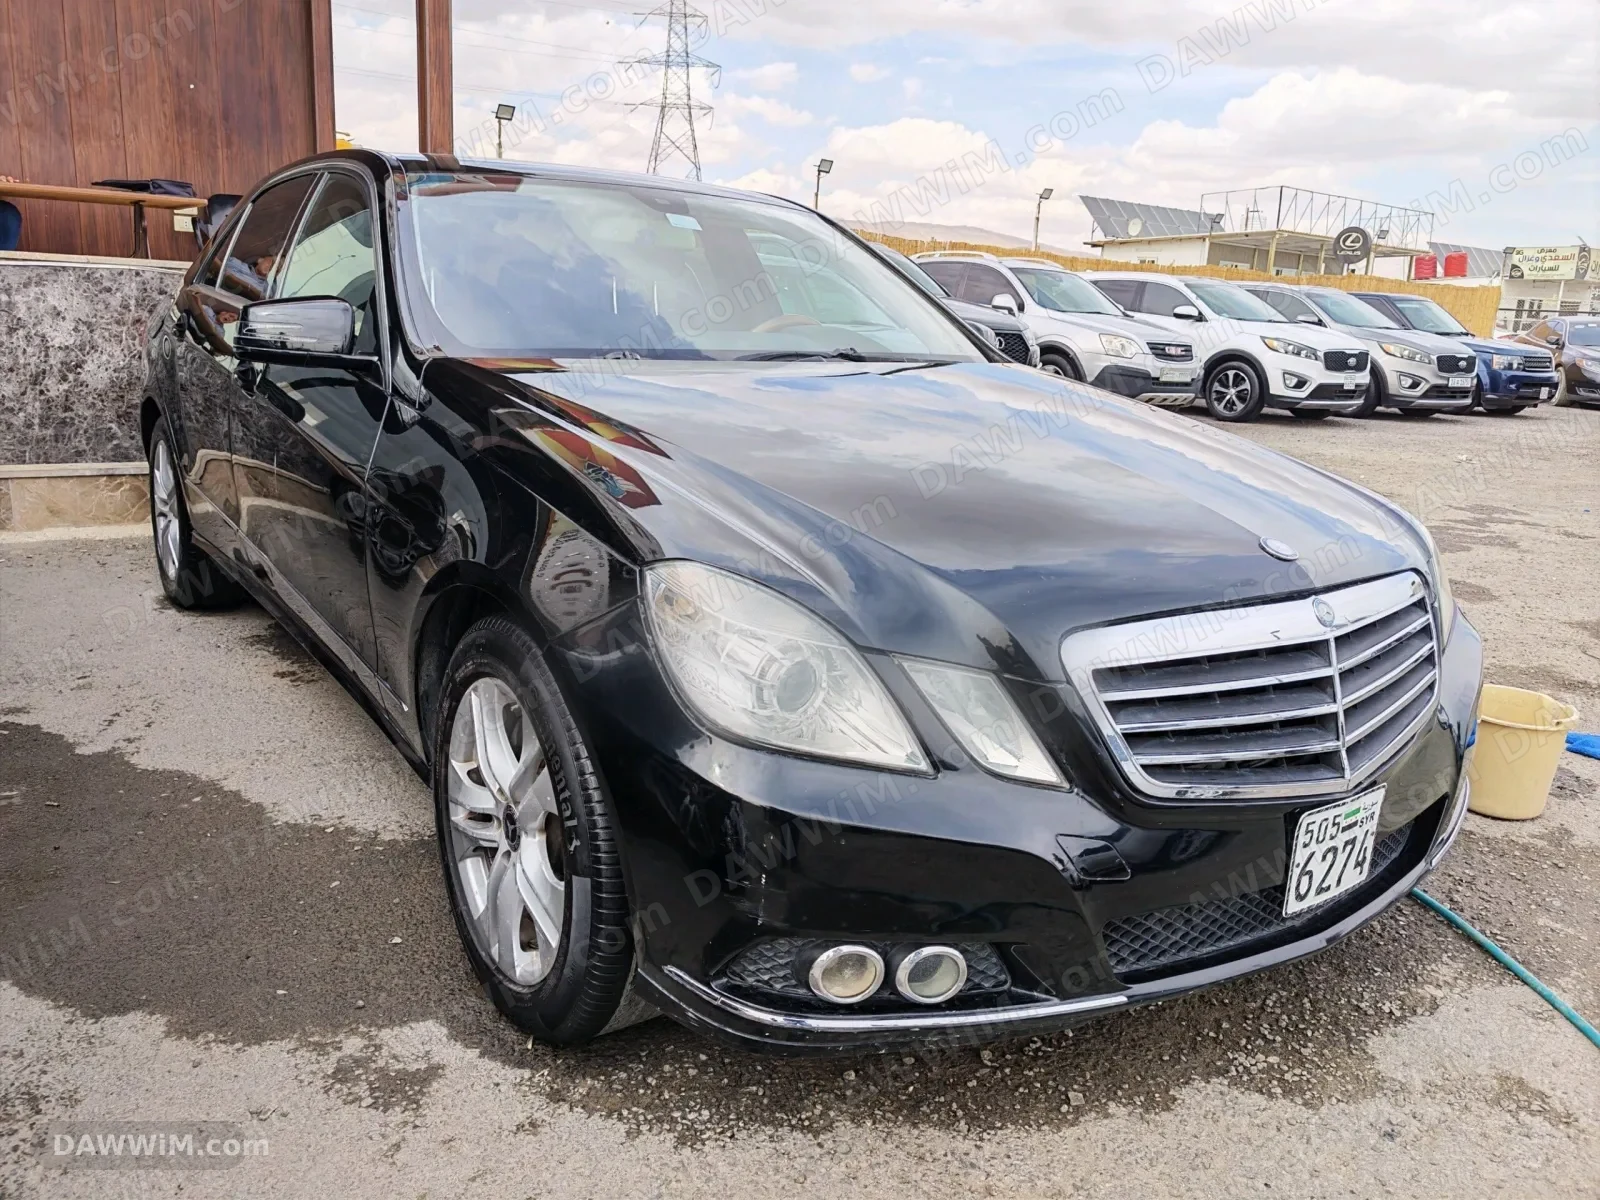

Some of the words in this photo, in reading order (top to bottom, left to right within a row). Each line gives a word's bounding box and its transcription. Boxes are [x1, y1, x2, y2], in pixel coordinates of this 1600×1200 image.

[1528, 264, 1560, 273] للسيارات
[1302, 813, 1343, 849] 505
[1359, 811, 1375, 828] SYR
[1295, 829, 1370, 903] 6274
